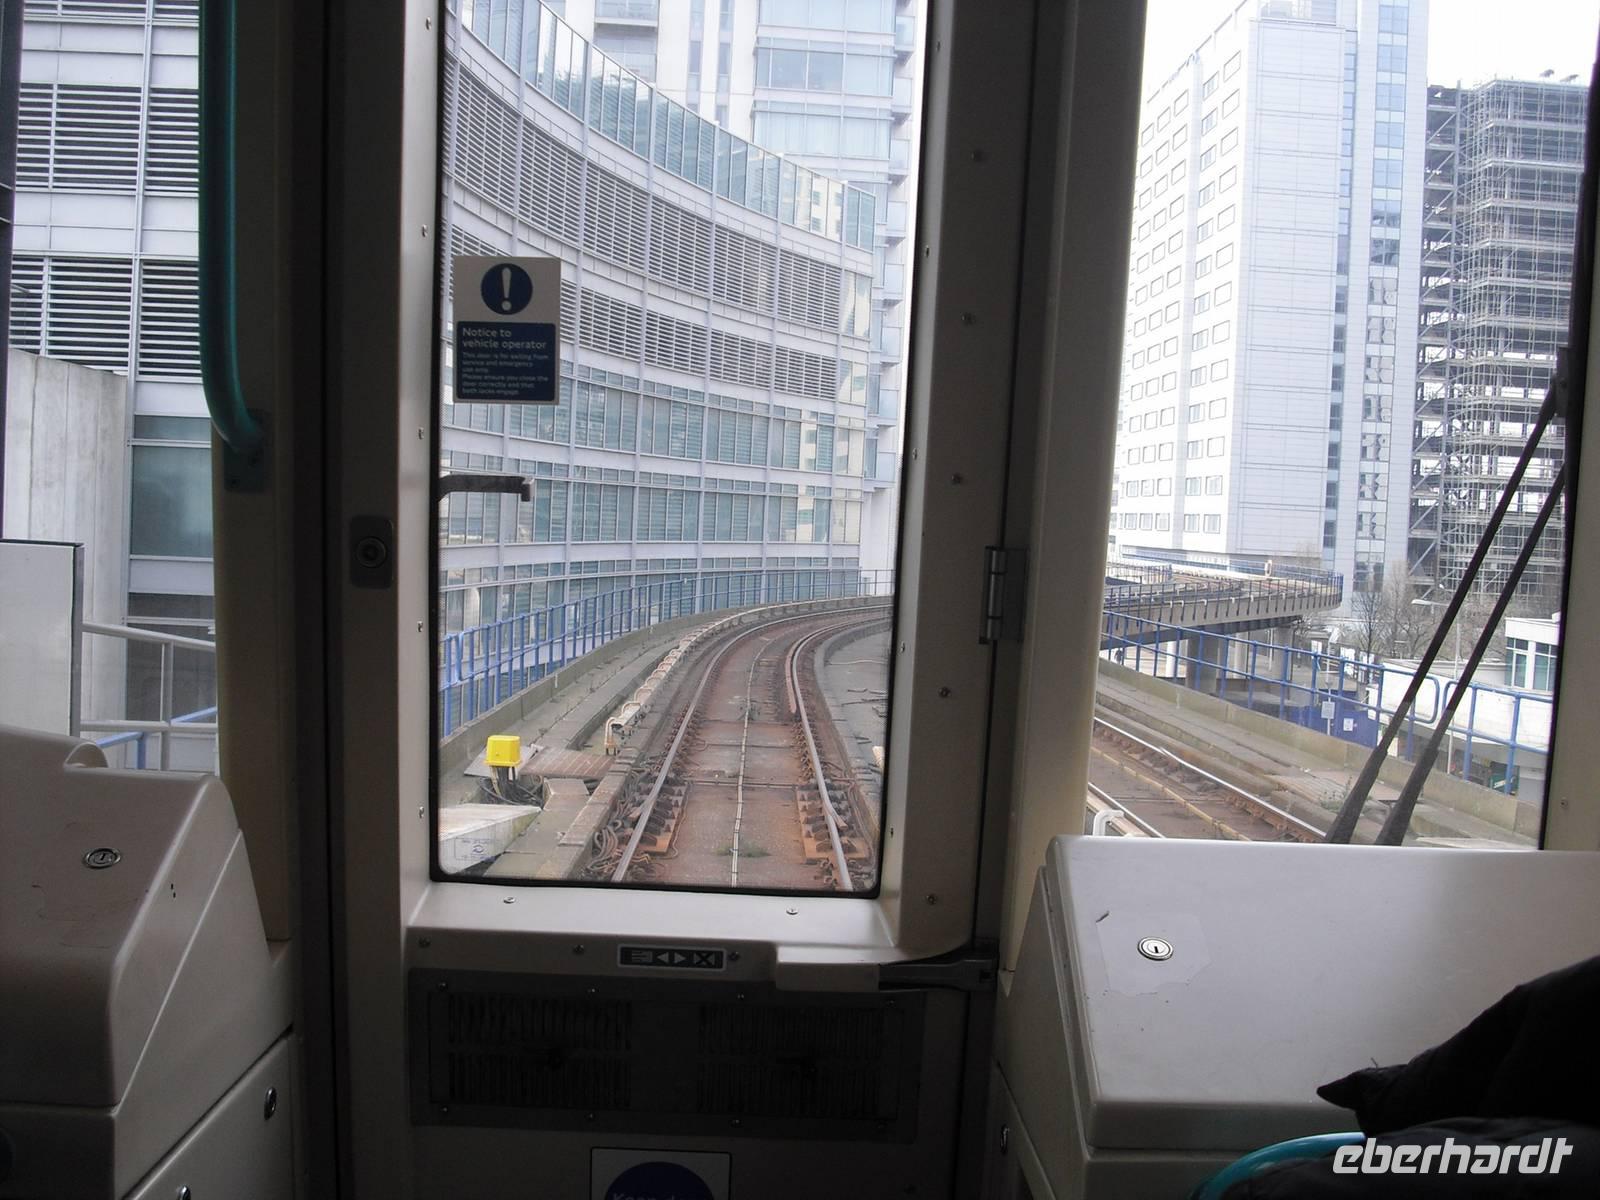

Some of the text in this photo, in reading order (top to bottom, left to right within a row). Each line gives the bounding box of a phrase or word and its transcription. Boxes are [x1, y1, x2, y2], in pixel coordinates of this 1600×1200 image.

[462, 327, 512, 338] Notice to
[462, 339, 547, 350] vehicle operator
